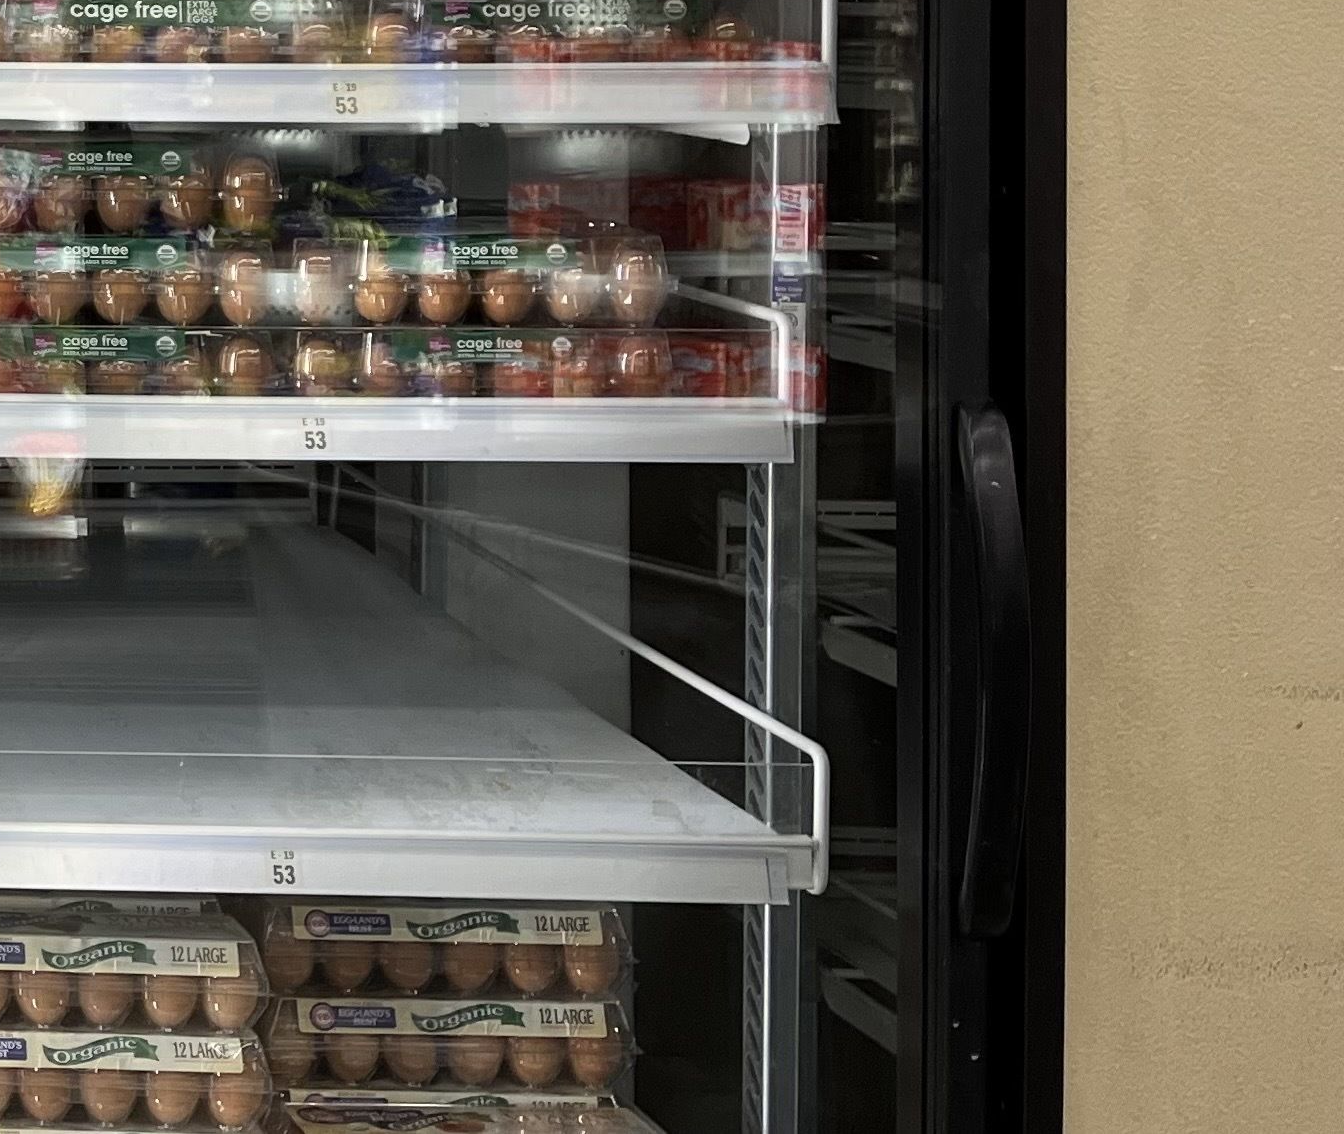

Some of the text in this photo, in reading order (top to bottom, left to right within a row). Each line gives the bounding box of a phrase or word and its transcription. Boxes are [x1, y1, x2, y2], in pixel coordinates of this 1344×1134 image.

[70, 0, 178, 23] cage free
[482, 0, 592, 22] cage free
[332, 82, 338, 92] E
[336, 96, 358, 114] 53
[68, 150, 133, 164] cage free
[63, 243, 129, 258] cage free
[452, 243, 519, 258] cage free
[62, 334, 128, 349] cage free
[456, 336, 523, 352] cage free
[304, 430, 327, 450] 53
[270, 850, 294, 860] E 19
[274, 864, 296, 884] 53
[416, 914, 500, 938] Organic
[534, 916, 590, 932] 12 LARGE
[51, 942, 135, 968] Organic
[170, 946, 228, 964] 12 LARGE
[422, 1006, 504, 1031] Organic
[538, 1008, 594, 1025] 12 LARGE
[52, 1039, 136, 1065] Organic
[173, 1042, 187, 1058] 12
